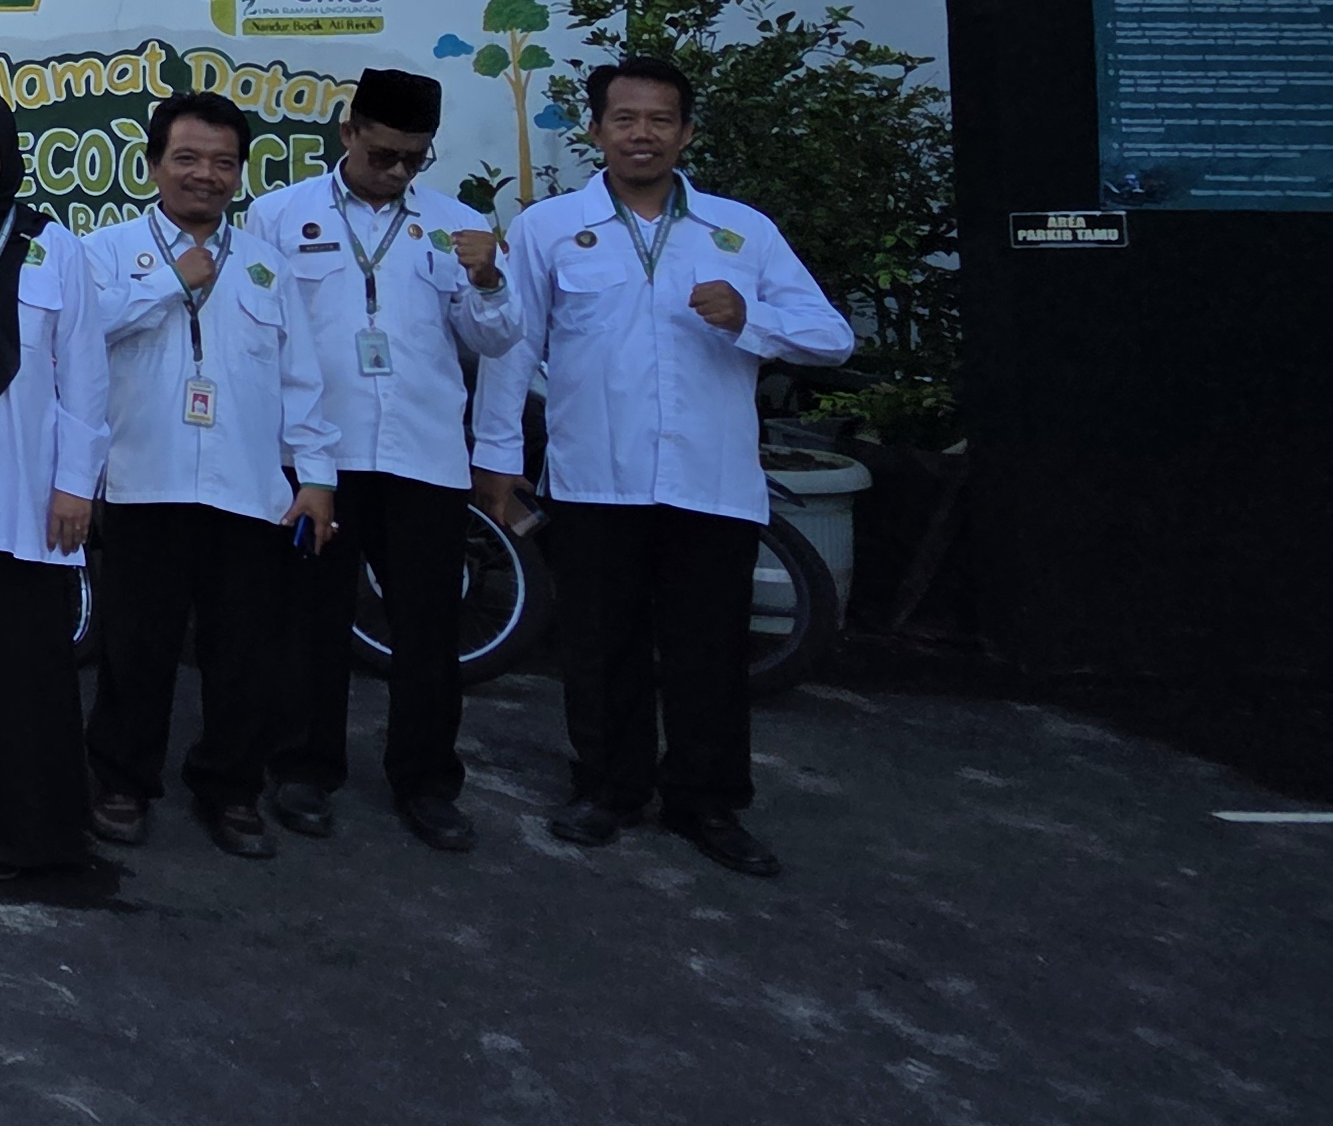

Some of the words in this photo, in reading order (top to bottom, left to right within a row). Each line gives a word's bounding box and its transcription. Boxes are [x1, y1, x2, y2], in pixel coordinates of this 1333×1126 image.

[1047, 216, 1086, 228] AREA
[1017, 229, 1073, 241] PARKIR
[1075, 228, 1119, 241] TAMU
